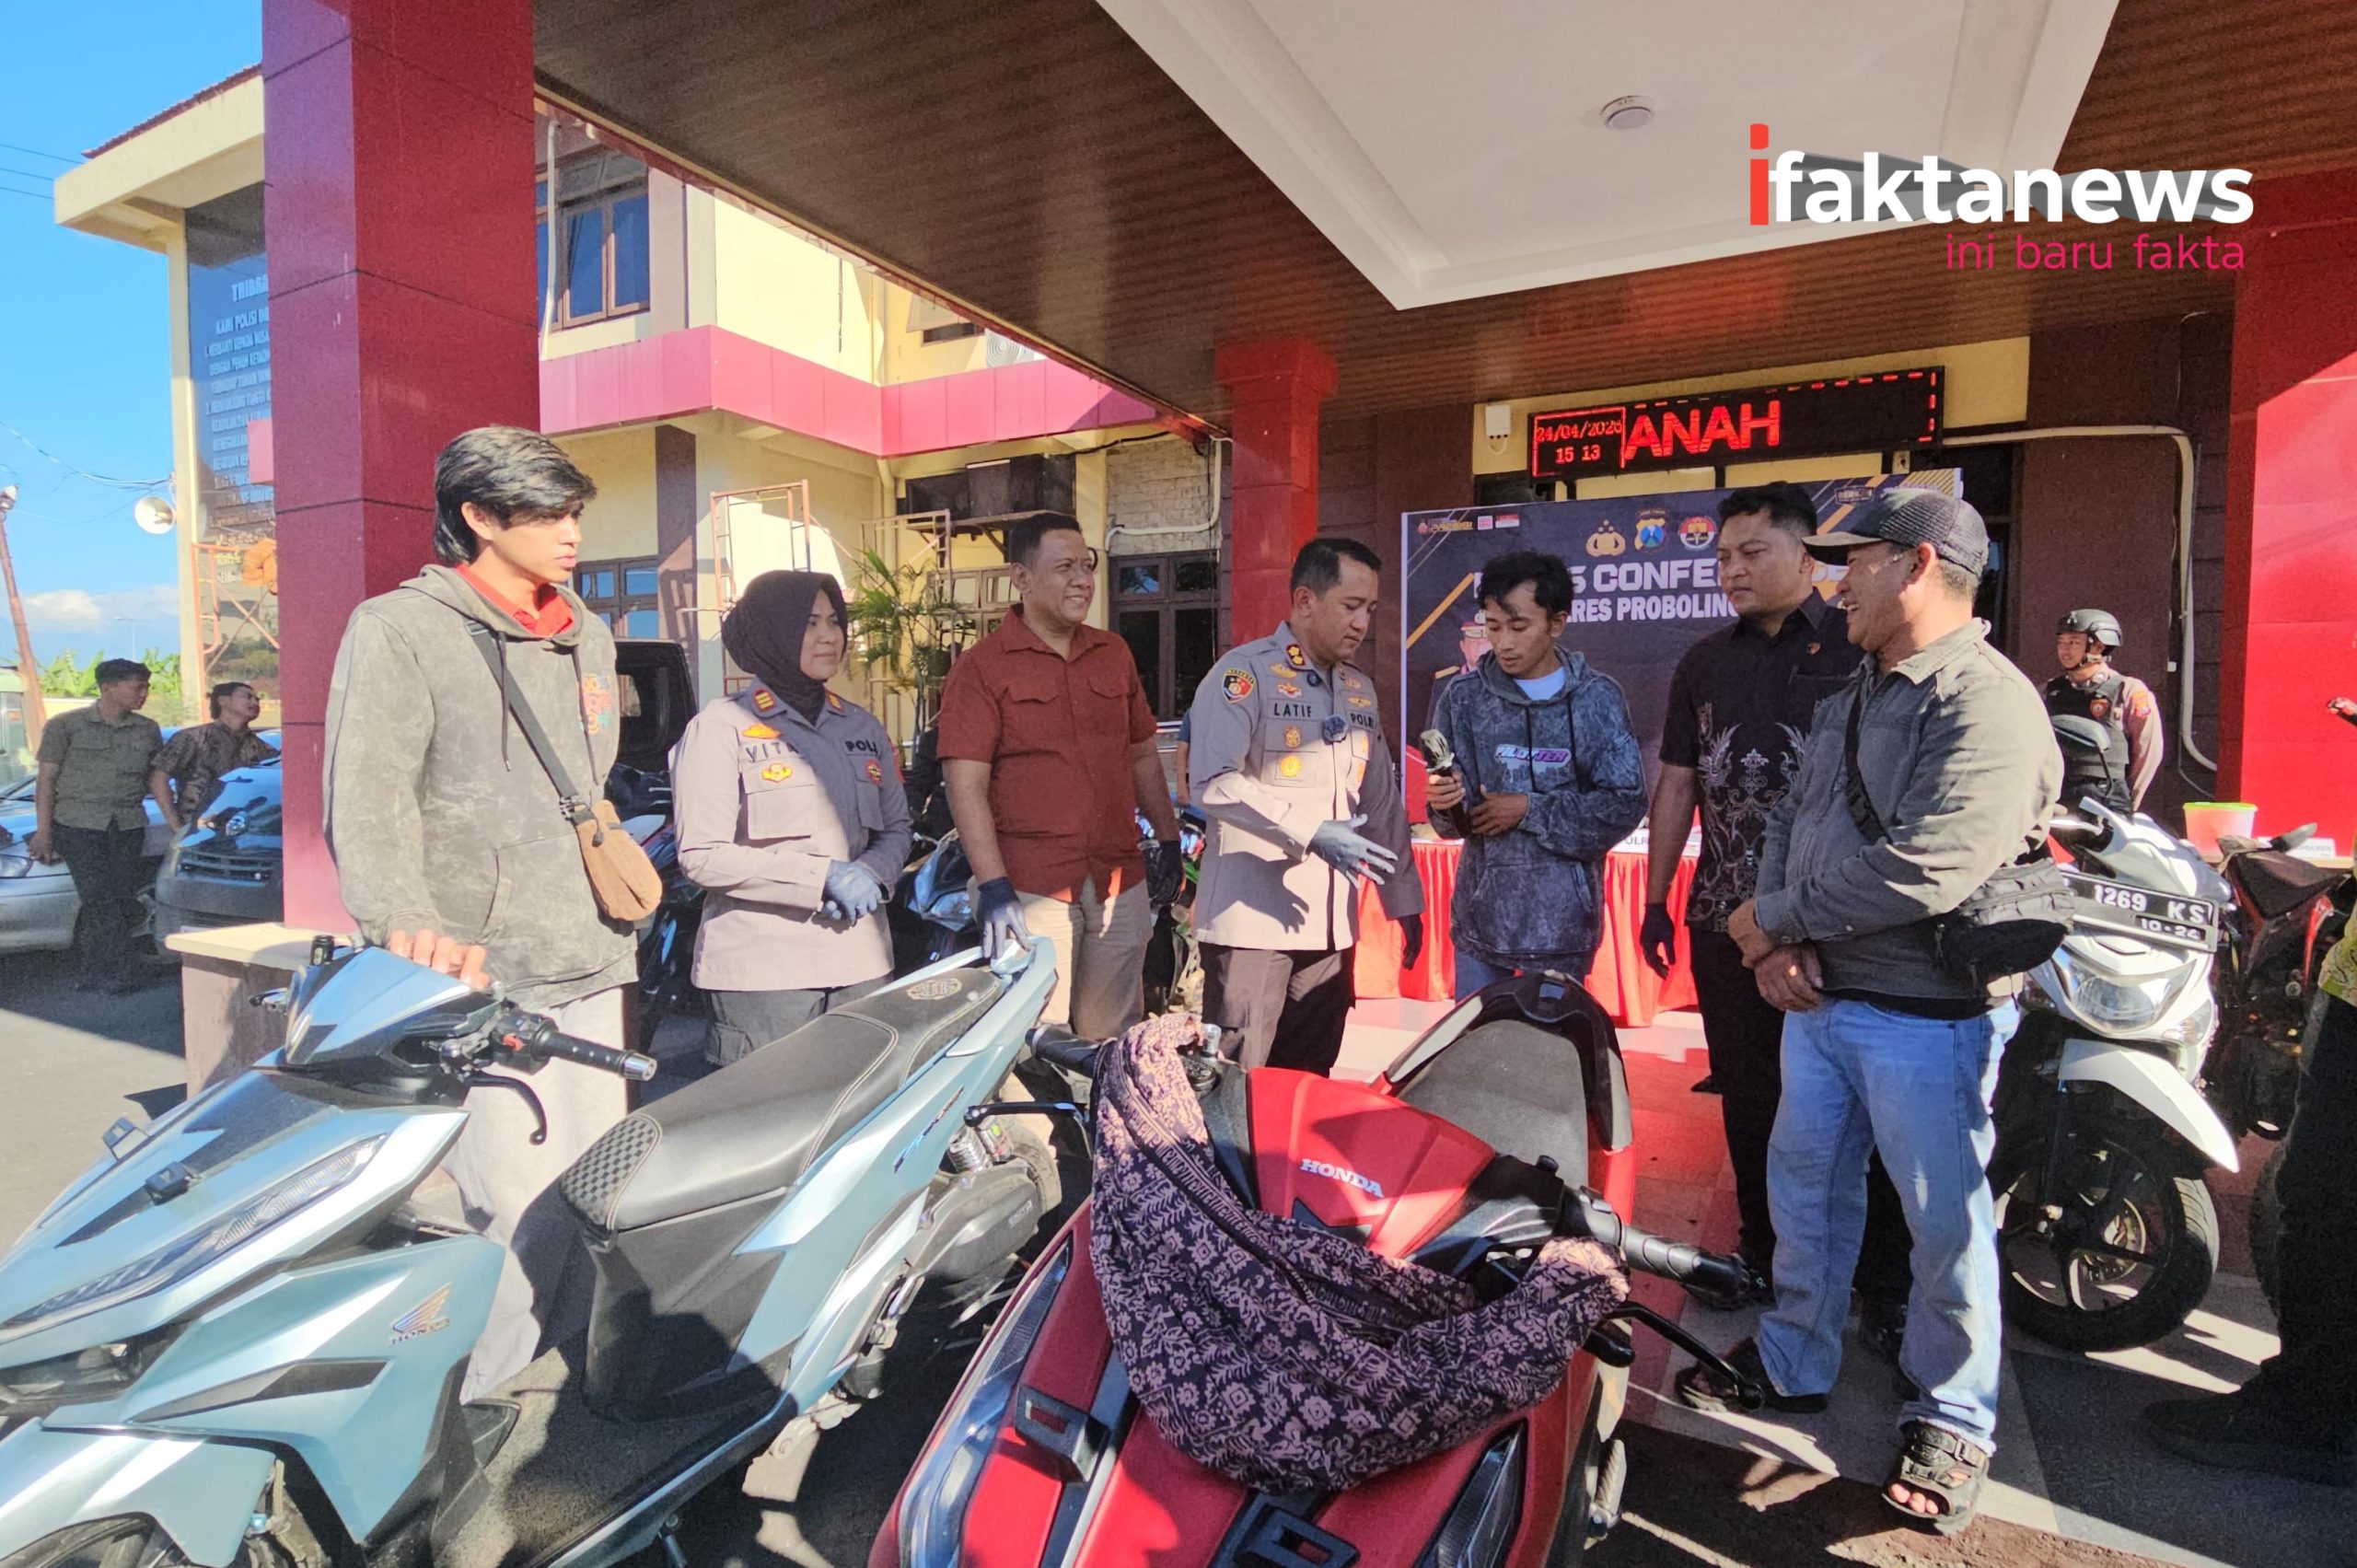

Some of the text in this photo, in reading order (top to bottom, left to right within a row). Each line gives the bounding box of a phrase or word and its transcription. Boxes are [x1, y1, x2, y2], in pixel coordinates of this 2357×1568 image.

[1624, 401, 1781, 460] ANAH
[1273, 703, 1312, 717] LATIF
[2094, 884, 2148, 912] 1269
[1300, 1158, 1384, 1198] HONDA
